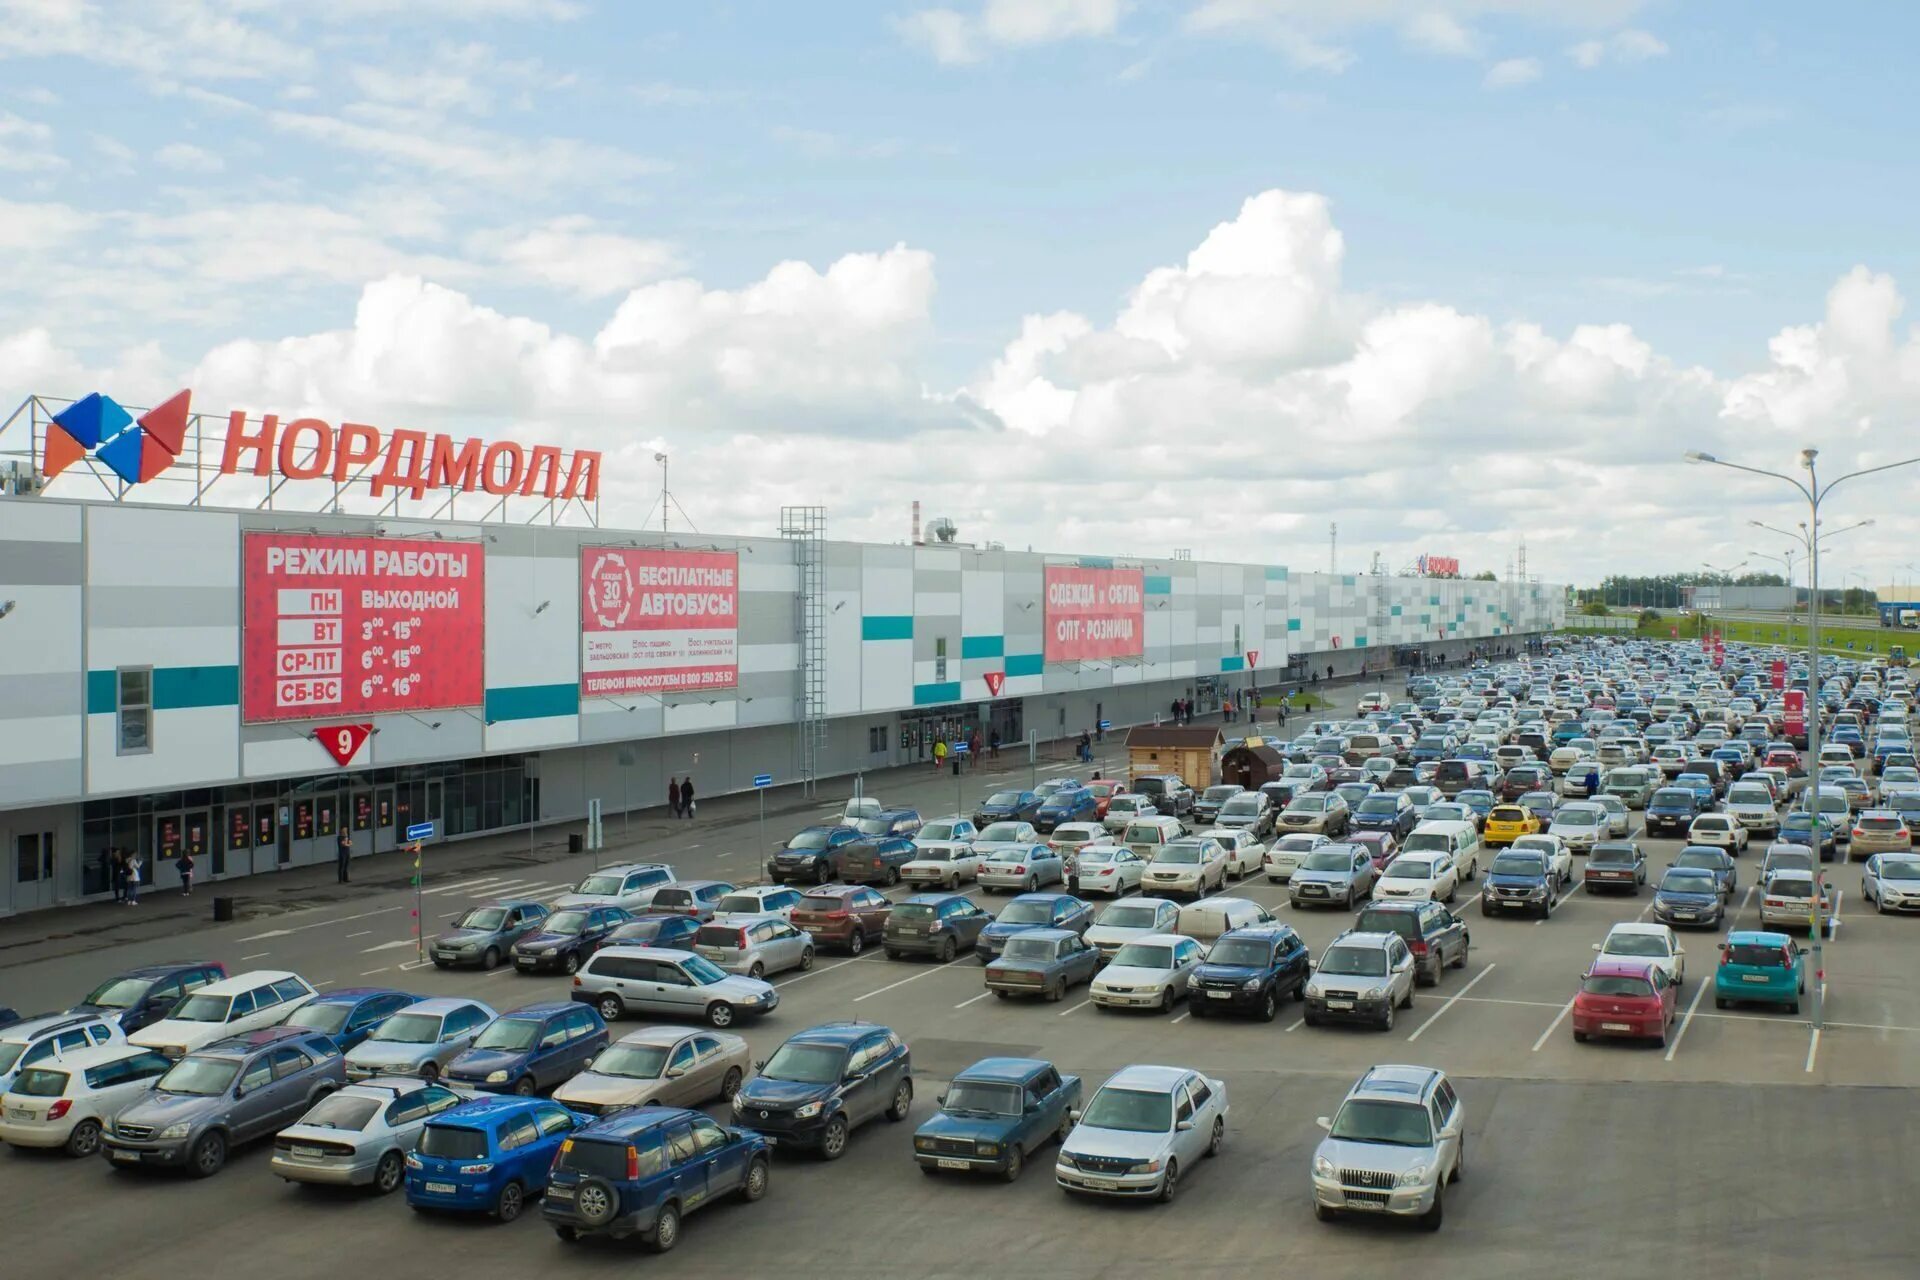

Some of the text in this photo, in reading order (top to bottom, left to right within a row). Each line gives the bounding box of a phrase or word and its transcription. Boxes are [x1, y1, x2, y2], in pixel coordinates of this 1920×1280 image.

[220, 410, 603, 501] НОРДМОЛЛ
[267, 547, 467, 577] РЕЖИМ РАБОТЫ
[639, 566, 734, 587] БЕСПЛАТНЫЕ
[310, 587, 459, 611] ПН ВЫХОДНОЙ
[603, 581, 621, 600] 30
[1049, 583, 1095, 607] ОДЕЖДА
[1108, 584, 1139, 604] ОБУВЬ
[639, 593, 734, 616] АВТОБУСЫ
[314, 622, 337, 641] ВТ
[1057, 619, 1133, 641] ОПТ РОЗНИЦА
[281, 652, 337, 672] СР-ПТ
[281, 681, 337, 703] СБ-ВС
[586, 677, 625, 692] ТЕЛЕФОН
[626, 674, 680, 689] ИНФОСЛУЖБЫ
[993, 674, 999, 689] 8
[338, 730, 352, 755] 9
